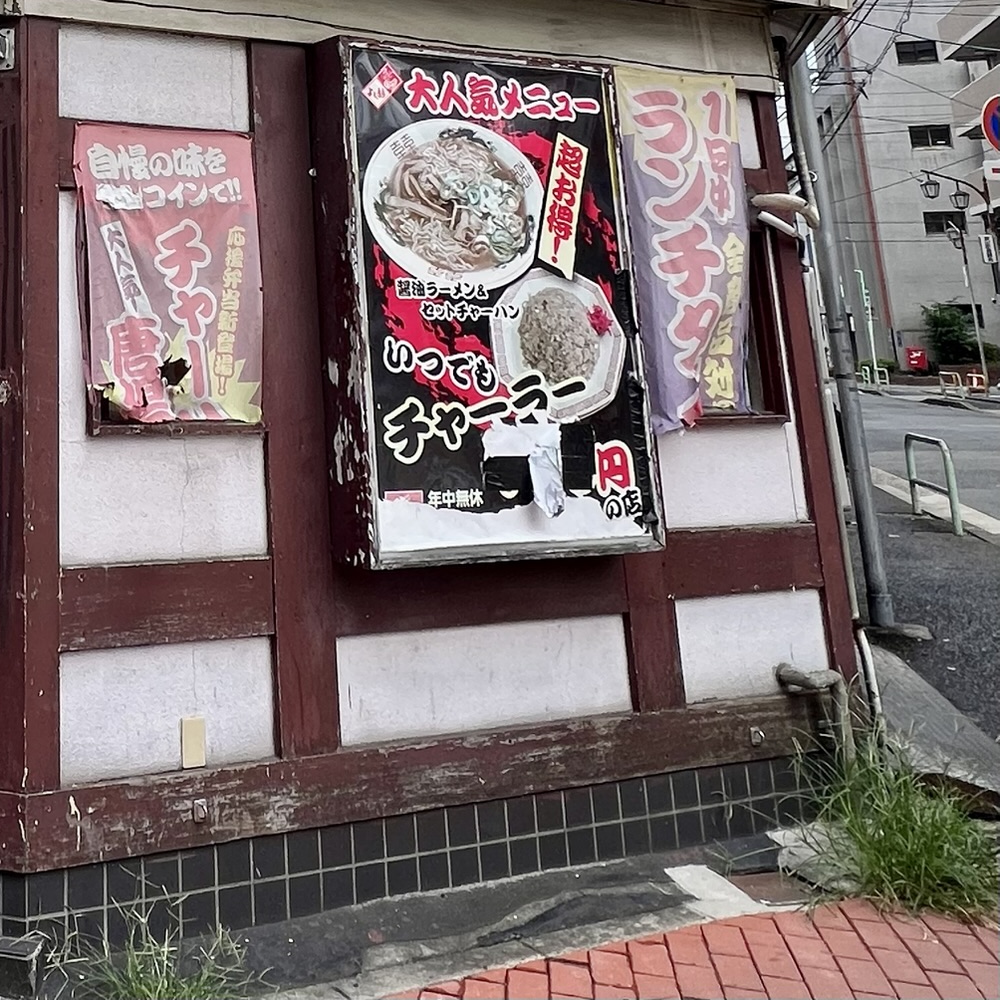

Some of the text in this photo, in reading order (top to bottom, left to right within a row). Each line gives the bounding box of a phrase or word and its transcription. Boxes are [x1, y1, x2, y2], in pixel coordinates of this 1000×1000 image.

[405, 68, 600, 121] 大人気メニュー
[86, 143, 227, 181] 自慢の味を
[701, 90, 735, 224] 1日中
[420, 302, 520, 321] セットチャーハン
[702, 231, 745, 408] 全商品対
[383, 336, 500, 395] いつでも
[383, 370, 587, 465] チャーラー
[427, 488, 484, 508] 年中無休
